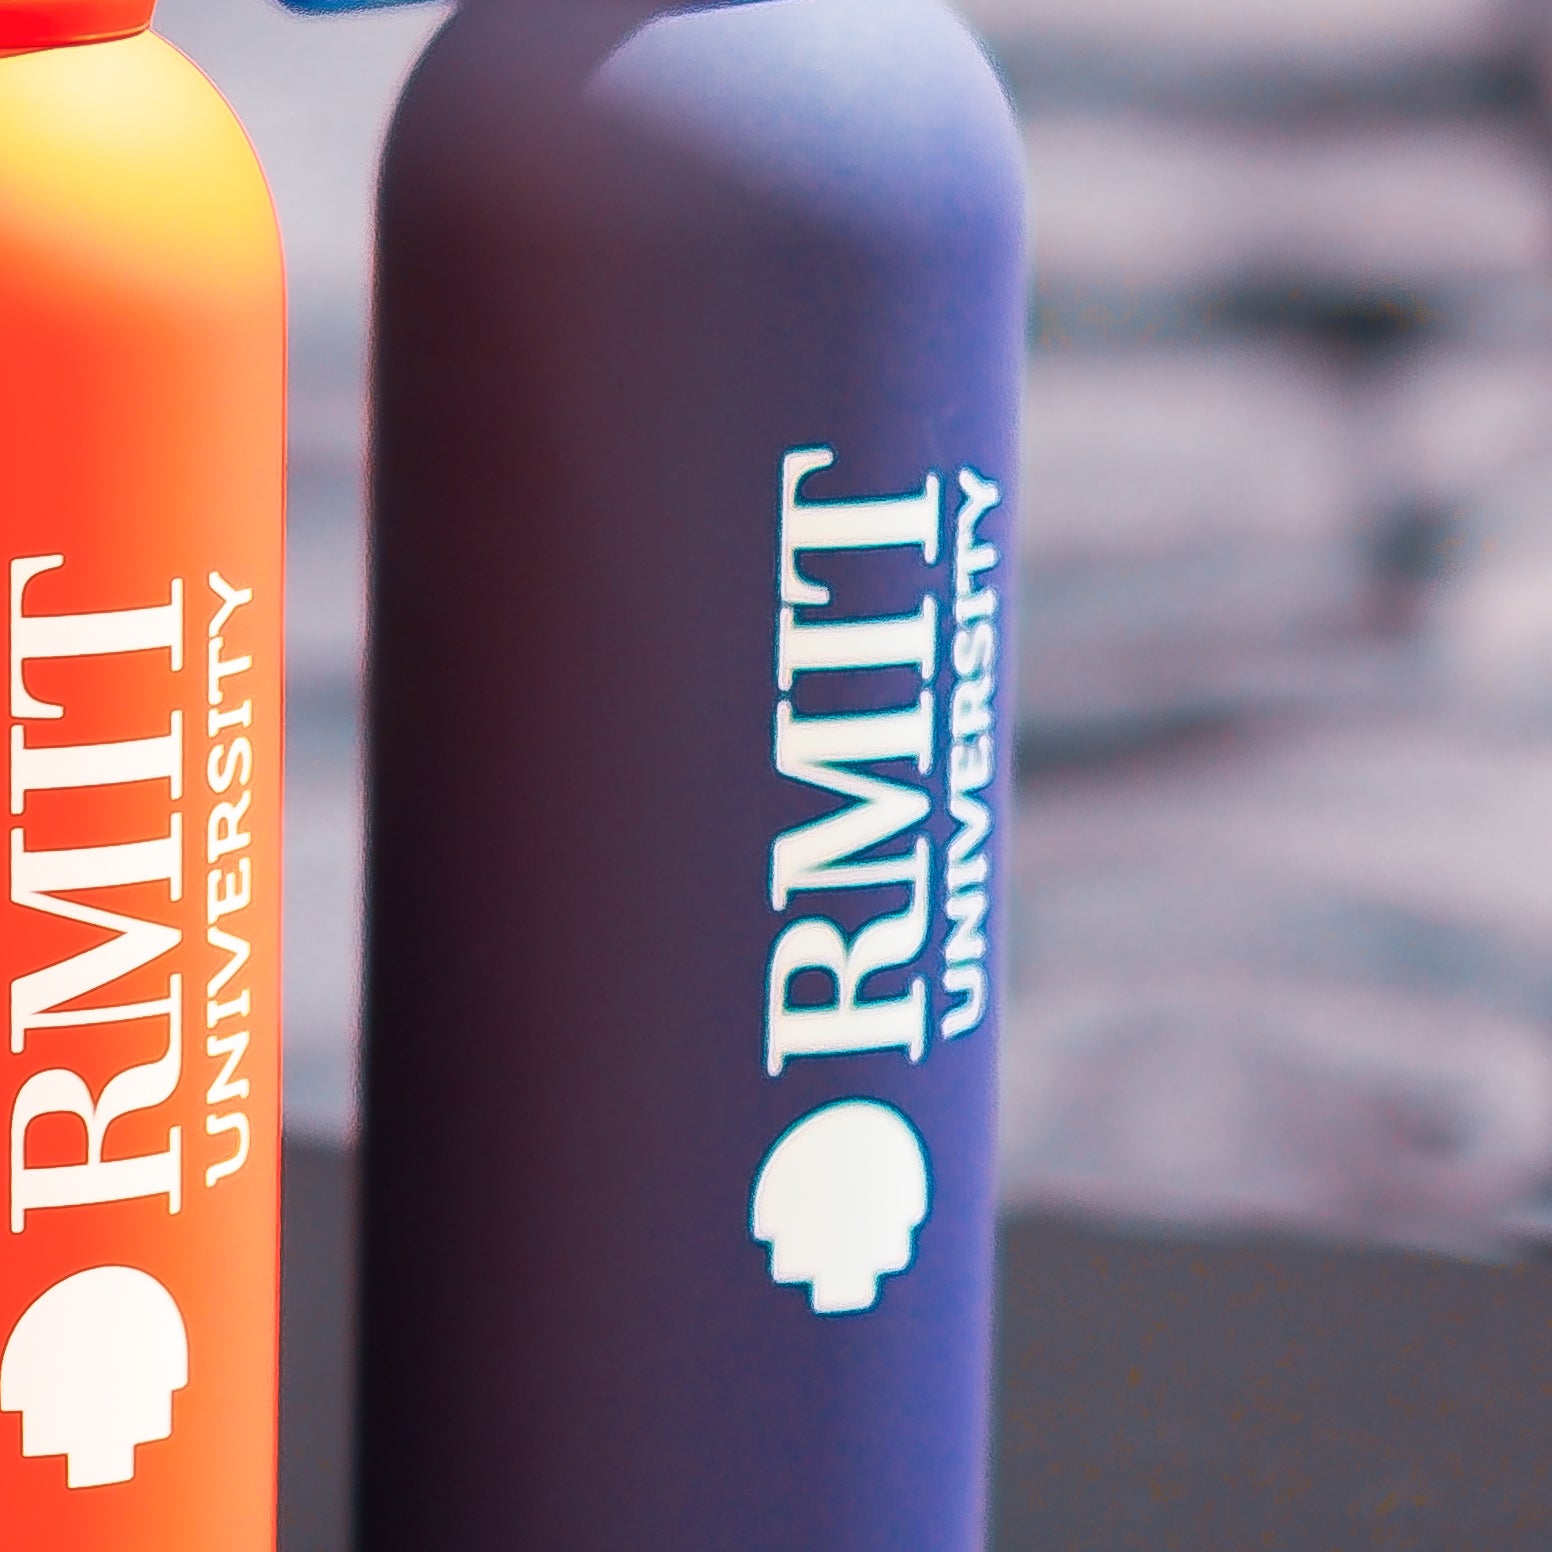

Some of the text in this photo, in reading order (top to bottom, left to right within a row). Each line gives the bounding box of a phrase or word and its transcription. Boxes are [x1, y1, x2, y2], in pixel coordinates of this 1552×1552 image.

[9, 553, 185, 1234] RMIT
[205, 569, 253, 1189] UNIVERSITY
[765, 448, 941, 1078] RMIT
[939, 467, 1001, 1043] UNIVERSITY
